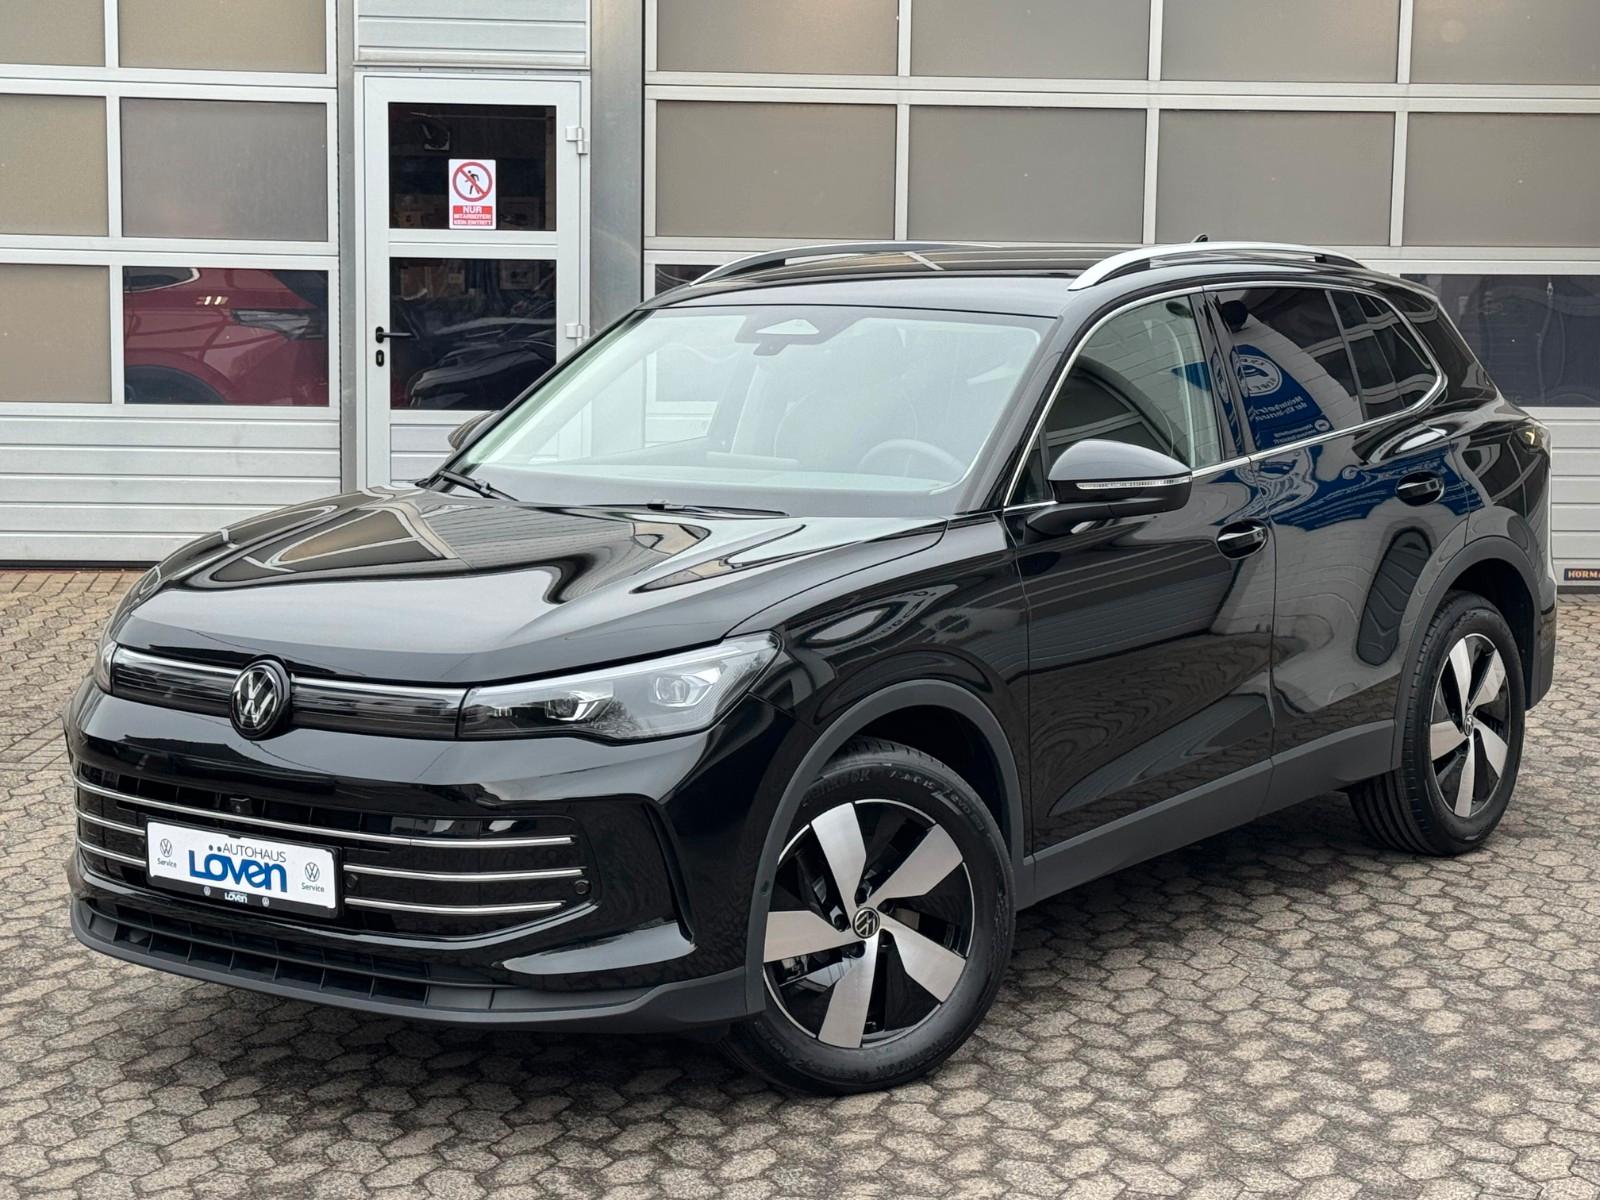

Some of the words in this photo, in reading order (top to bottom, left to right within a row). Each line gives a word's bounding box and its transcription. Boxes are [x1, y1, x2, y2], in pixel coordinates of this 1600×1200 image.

[1568, 570, 1600, 578] HORM
[232, 668, 277, 729] VW
[222, 843, 287, 862] AUTOHAUS
[157, 857, 177, 868] Service
[301, 882, 325, 893] Service
